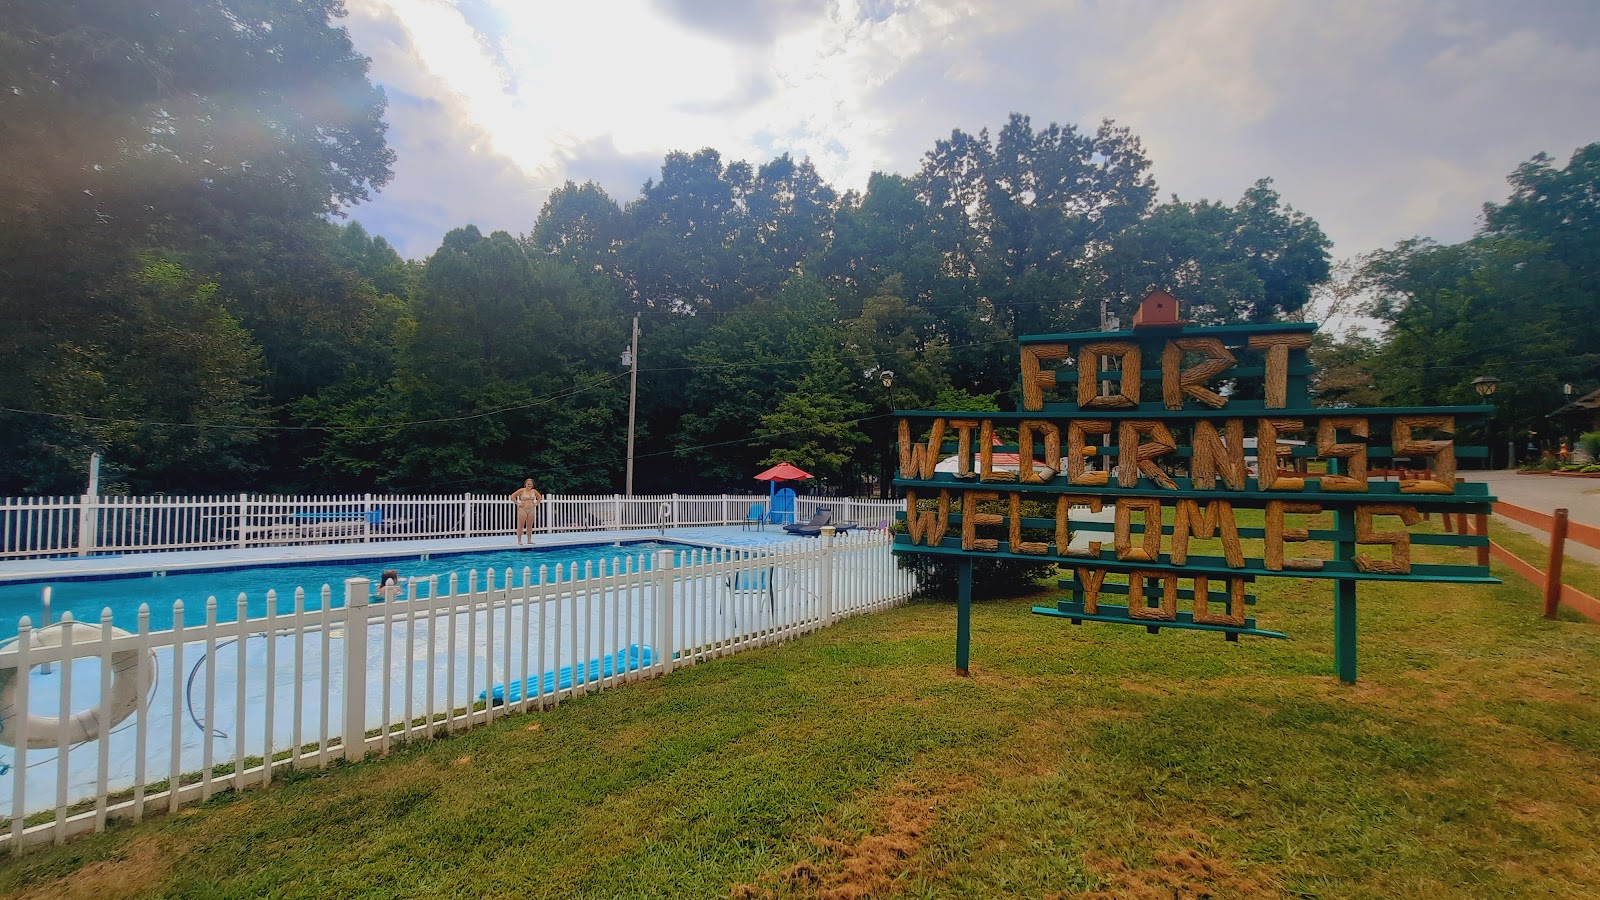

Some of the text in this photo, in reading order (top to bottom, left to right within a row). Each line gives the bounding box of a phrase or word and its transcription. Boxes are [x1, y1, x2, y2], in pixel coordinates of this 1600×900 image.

[1020, 335, 1311, 411] FORT
[898, 416, 1456, 493] WILDERNESS
[906, 489, 1423, 574] WELCOMES
[1078, 567, 1246, 626] YOU
